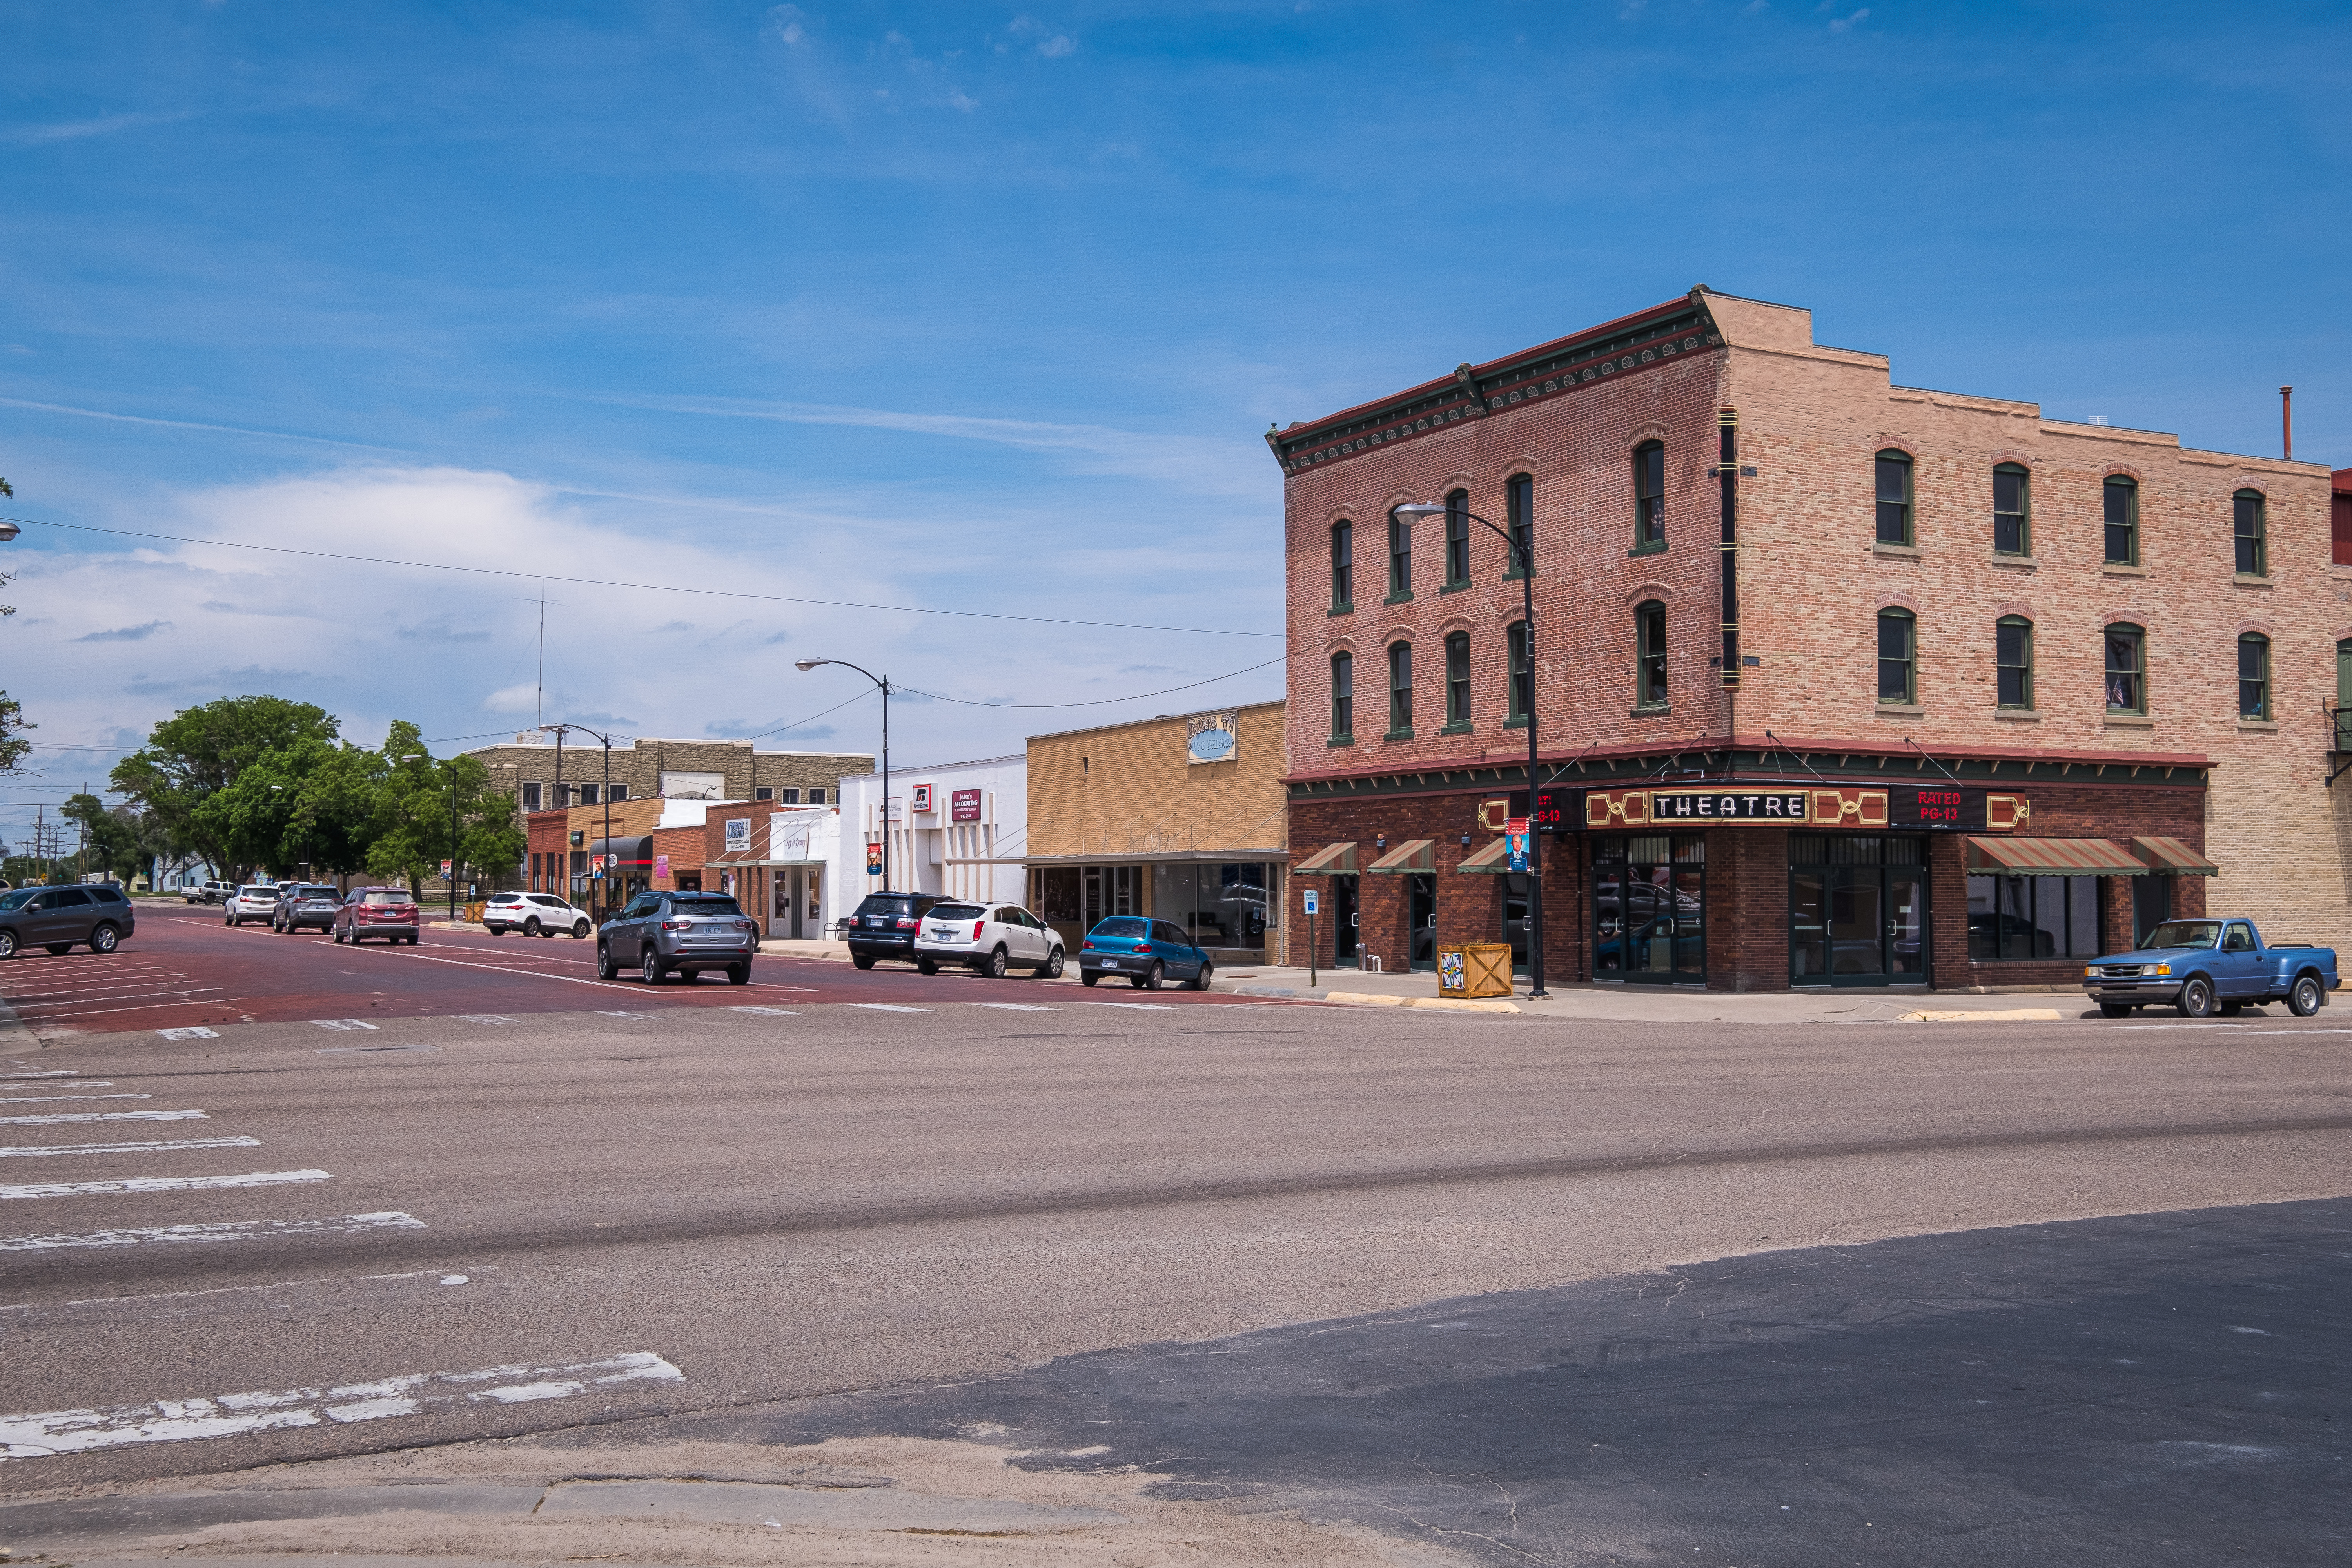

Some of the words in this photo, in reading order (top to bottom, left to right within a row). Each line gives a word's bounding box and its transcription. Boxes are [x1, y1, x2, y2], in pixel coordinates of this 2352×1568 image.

[1918, 792, 1960, 804] RATED
[1657, 797, 1802, 816] THEATRE
[1539, 810, 1560, 822] G-13
[1921, 808, 1957, 820] PG-13
